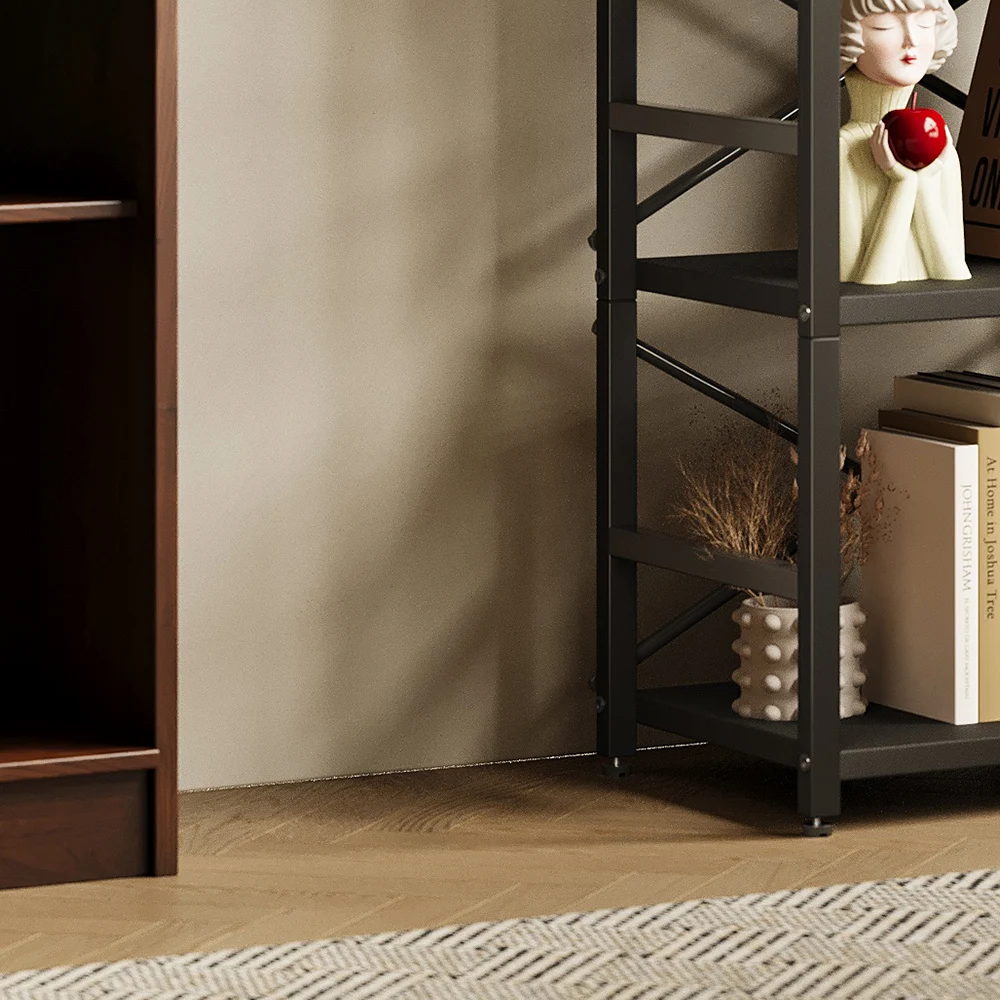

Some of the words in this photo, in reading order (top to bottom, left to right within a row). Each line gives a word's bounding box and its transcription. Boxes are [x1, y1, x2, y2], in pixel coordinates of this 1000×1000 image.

[986, 456, 998, 472] At
[961, 484, 972, 523] JOHN
[986, 478, 997, 517] Home
[986, 522, 997, 535] in
[962, 525, 972, 592] GRISHAM
[983, 537, 998, 585] Joshua
[986, 590, 998, 620] Tree
